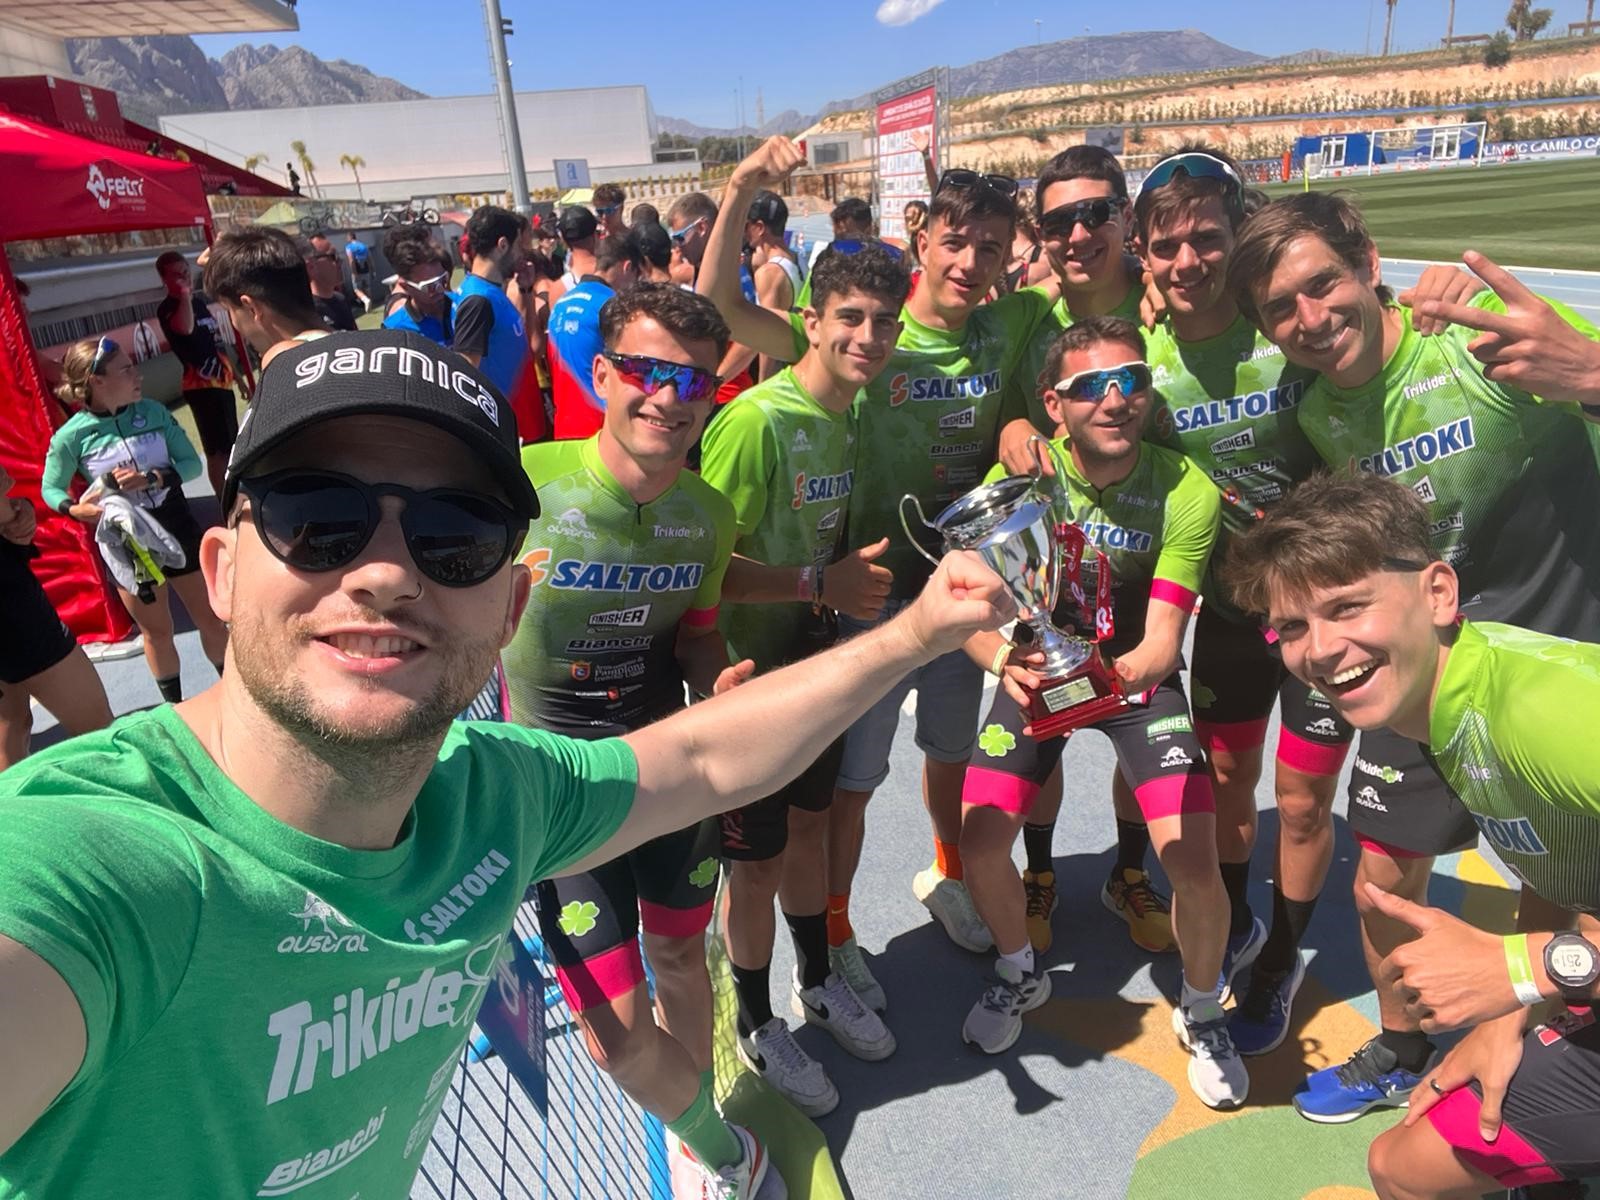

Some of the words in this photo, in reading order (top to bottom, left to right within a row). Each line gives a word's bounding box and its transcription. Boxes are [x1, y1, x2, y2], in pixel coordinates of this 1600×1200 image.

[1483, 143, 1528, 156] LIMPIC
[1530, 138, 1581, 152] CAMILO
[295, 347, 499, 427] garnica
[911, 369, 1001, 400] SALTOKI
[1175, 379, 1304, 433] SALTOKI
[1212, 432, 1252, 453] FINISHER
[1083, 521, 1152, 552] LTOKI
[550, 559, 704, 592] SALTOKI
[590, 608, 646, 625] FINISHER
[566, 635, 652, 650] Bianchi
[1471, 811, 1549, 855] TOKI
[421, 849, 511, 936] SALTOKI
[277, 934, 369, 953] austral
[262, 1106, 388, 1187] Bianchi
